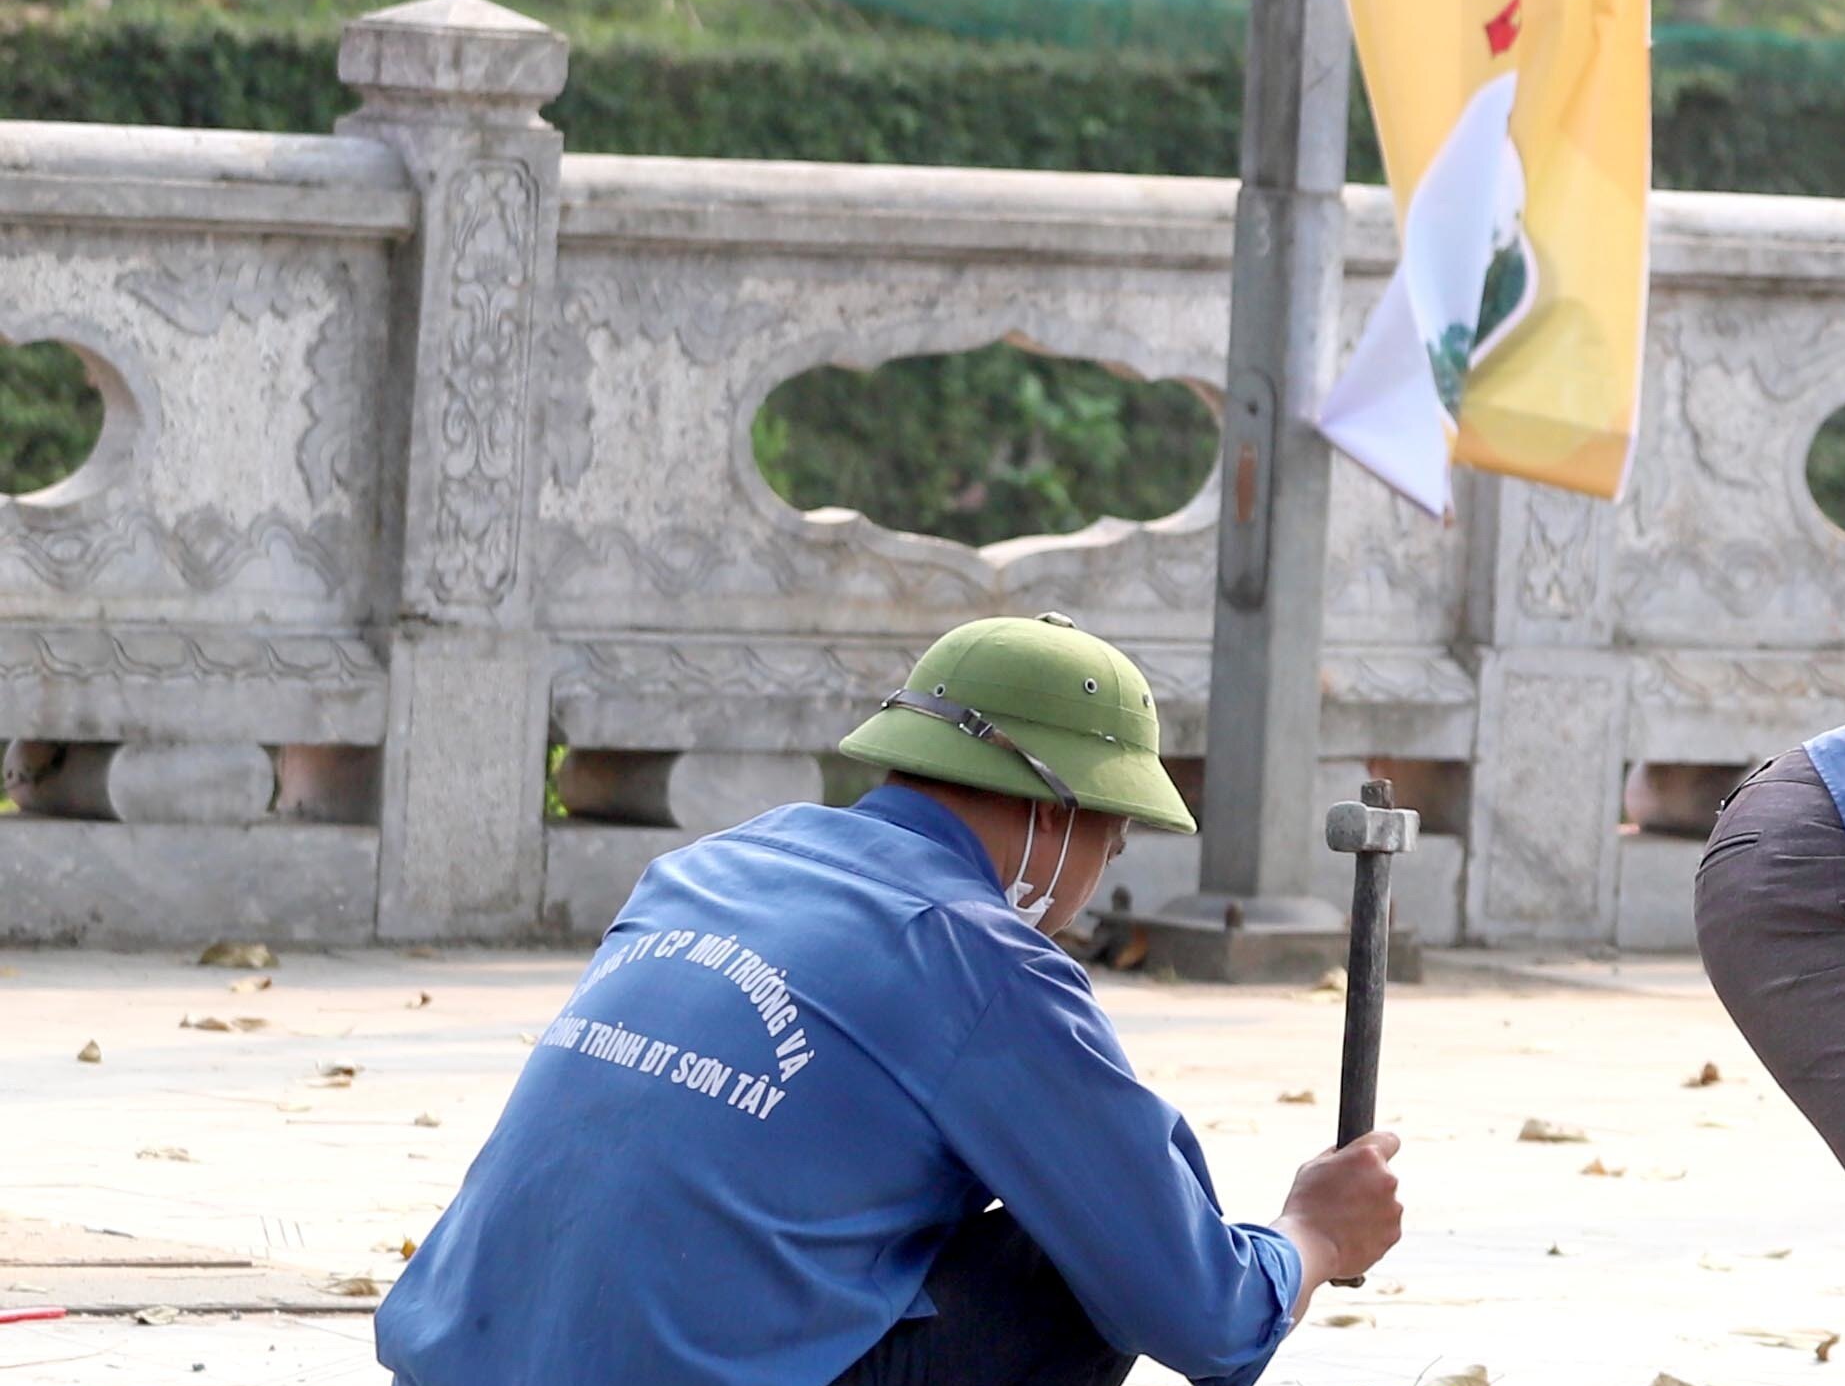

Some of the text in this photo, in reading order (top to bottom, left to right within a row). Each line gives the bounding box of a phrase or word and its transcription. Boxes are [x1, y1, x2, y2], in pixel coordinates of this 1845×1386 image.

[627, 931, 663, 964] TY
[654, 930, 696, 958] CP
[685, 933, 741, 970] MÔI
[723, 949, 798, 1038] TRƯỜNG
[775, 1028, 815, 1083] VÀ
[580, 1021, 649, 1068] TRÌNH
[671, 1051, 733, 1098] SƠN
[727, 1074, 786, 1120] TÂY
